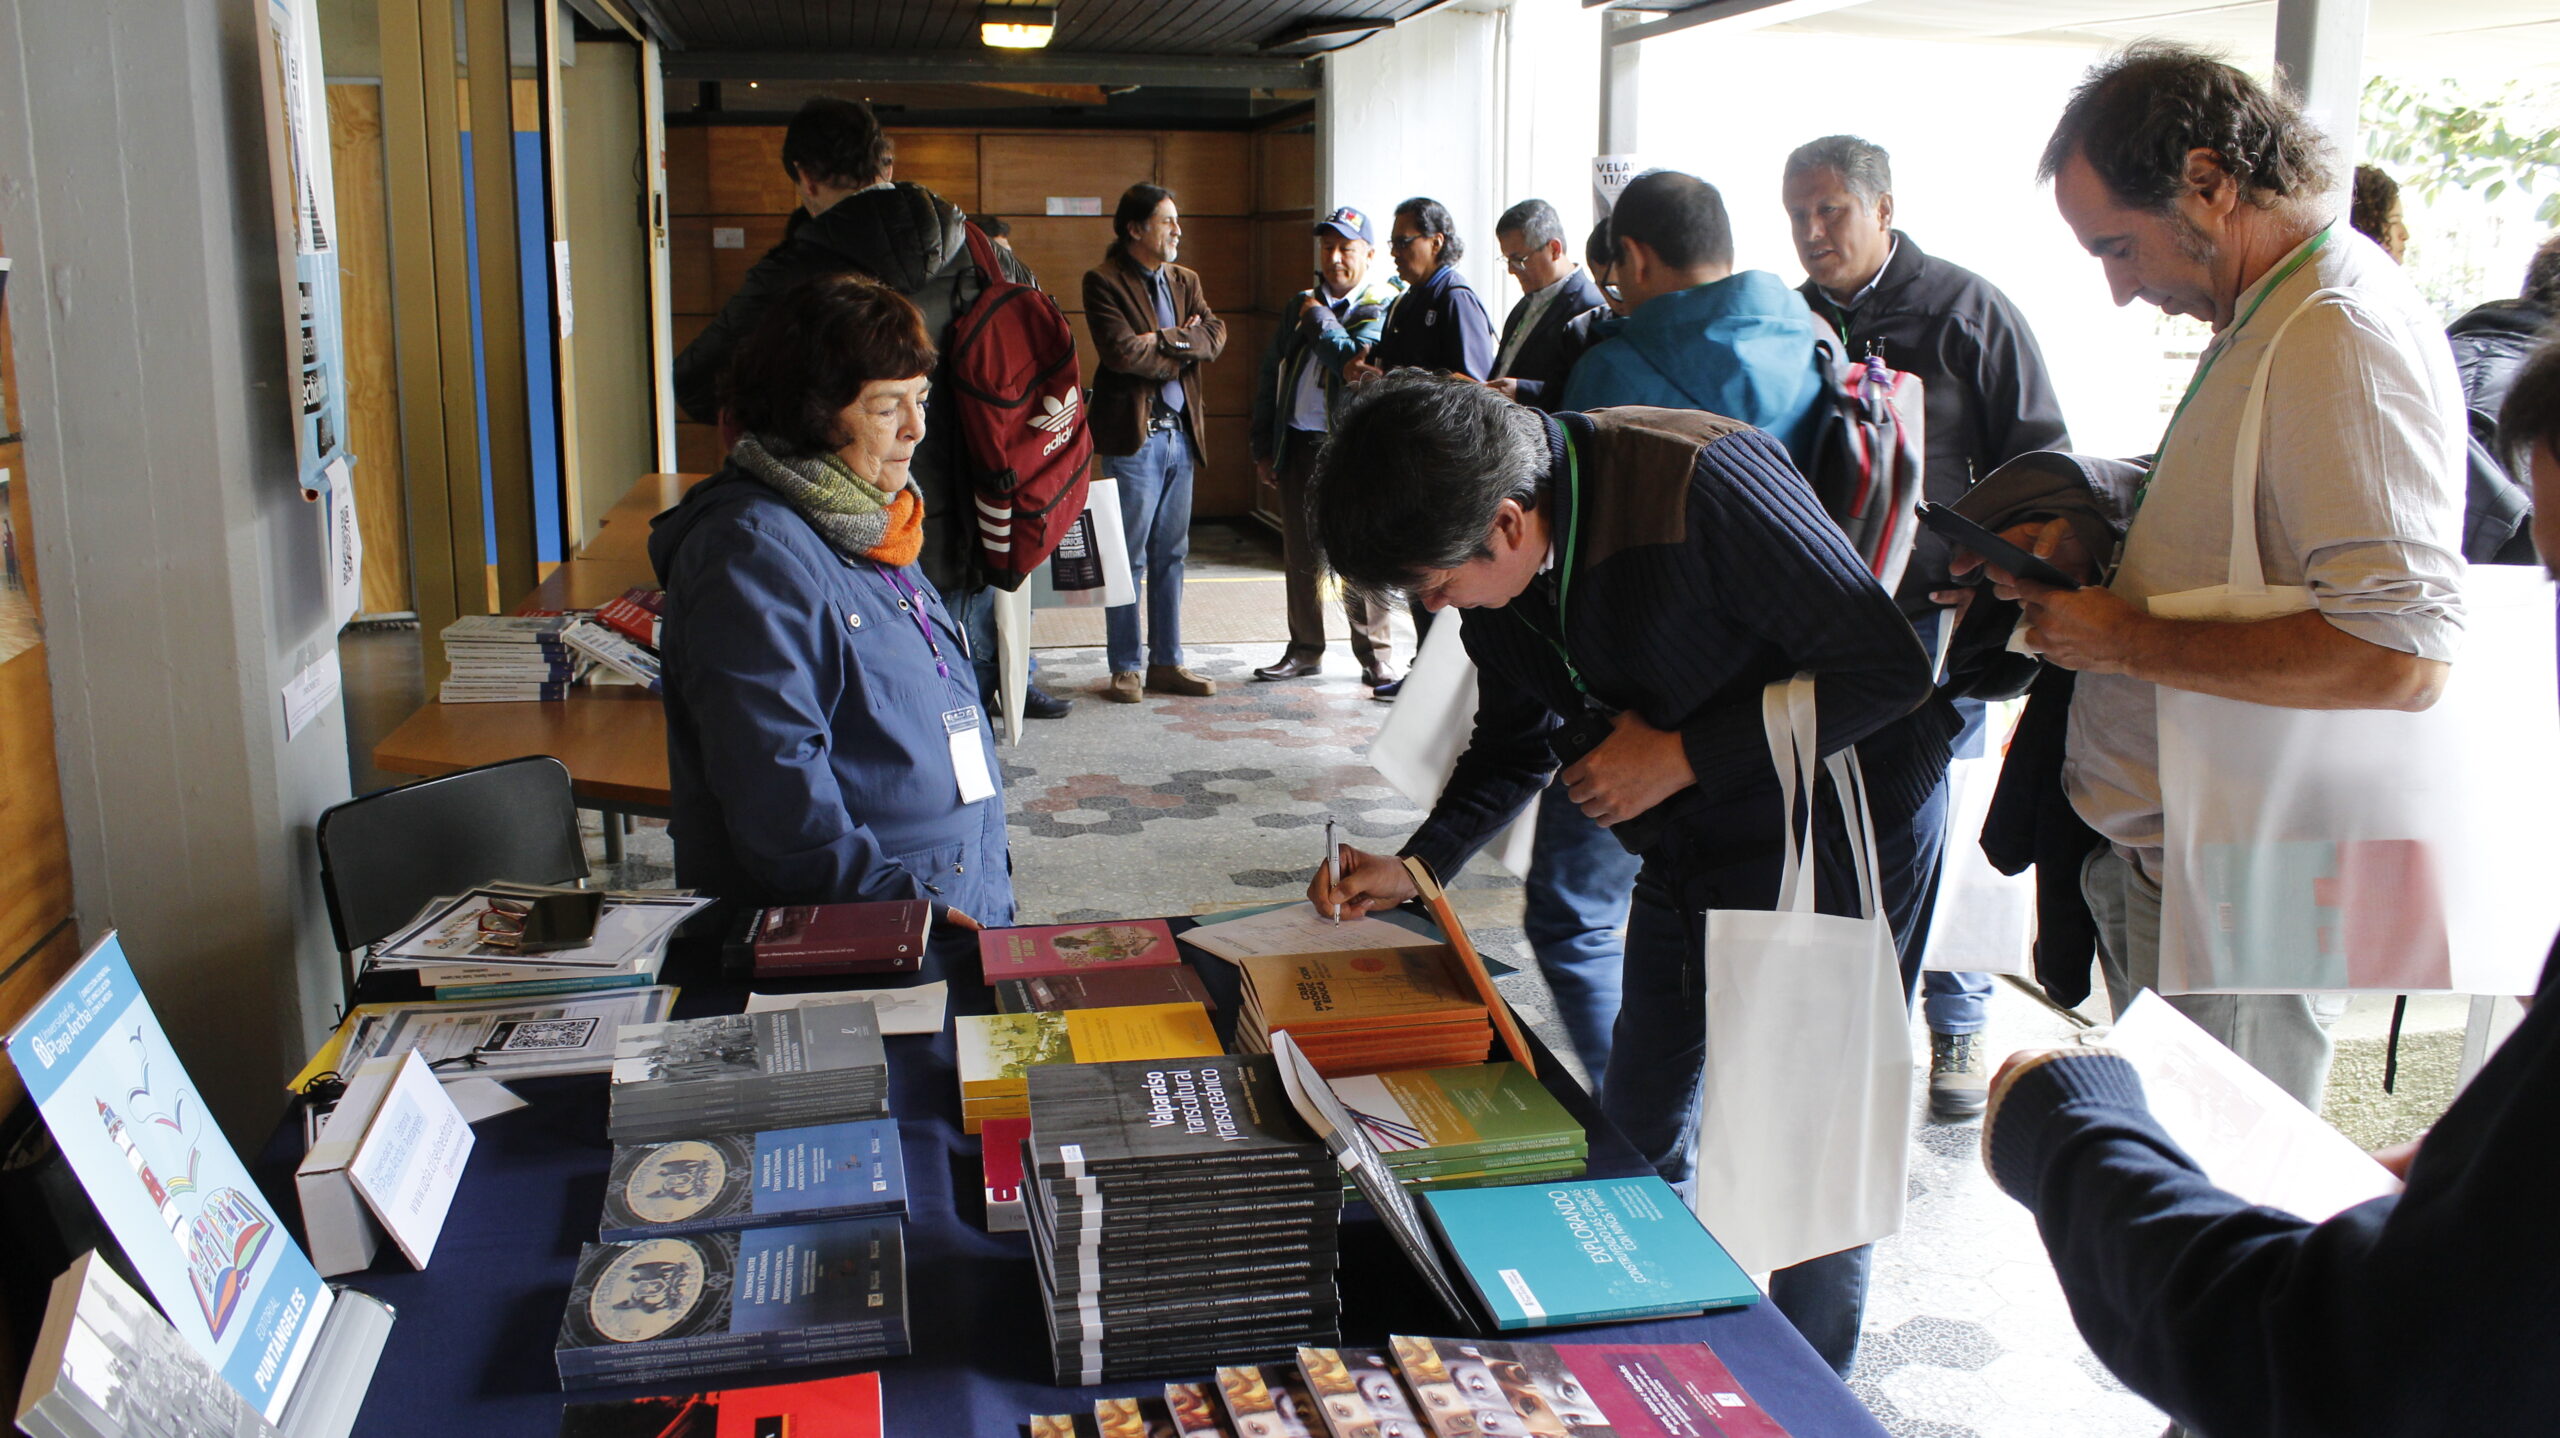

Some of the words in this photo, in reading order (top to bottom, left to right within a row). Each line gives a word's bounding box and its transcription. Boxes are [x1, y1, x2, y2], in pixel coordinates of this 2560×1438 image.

[1296, 982, 1309, 999] CREA
[1316, 981, 1331, 1002] EDUCA
[46, 1033, 72, 1059] Playa
[65, 1007, 92, 1039] Ancha
[1141, 1071, 1179, 1127] Valparaíso
[1166, 1070, 1206, 1133] transcultural
[1199, 1069, 1237, 1135] transoceánico
[1569, 1189, 1598, 1217] CIENCIAS
[1582, 1188, 1605, 1206] NIÑAS
[1548, 1190, 1612, 1263] EXPLORANDO
[1589, 1218, 1607, 1230] LAS
[1601, 1212, 1625, 1233] NIÑOS
[1618, 1235, 1637, 1250] CON
[1598, 1231, 1648, 1284] CONSTRUYENDO
[253, 1286, 307, 1392] PUNTÁNGELES
[254, 1299, 281, 1339] EDITORIAL
